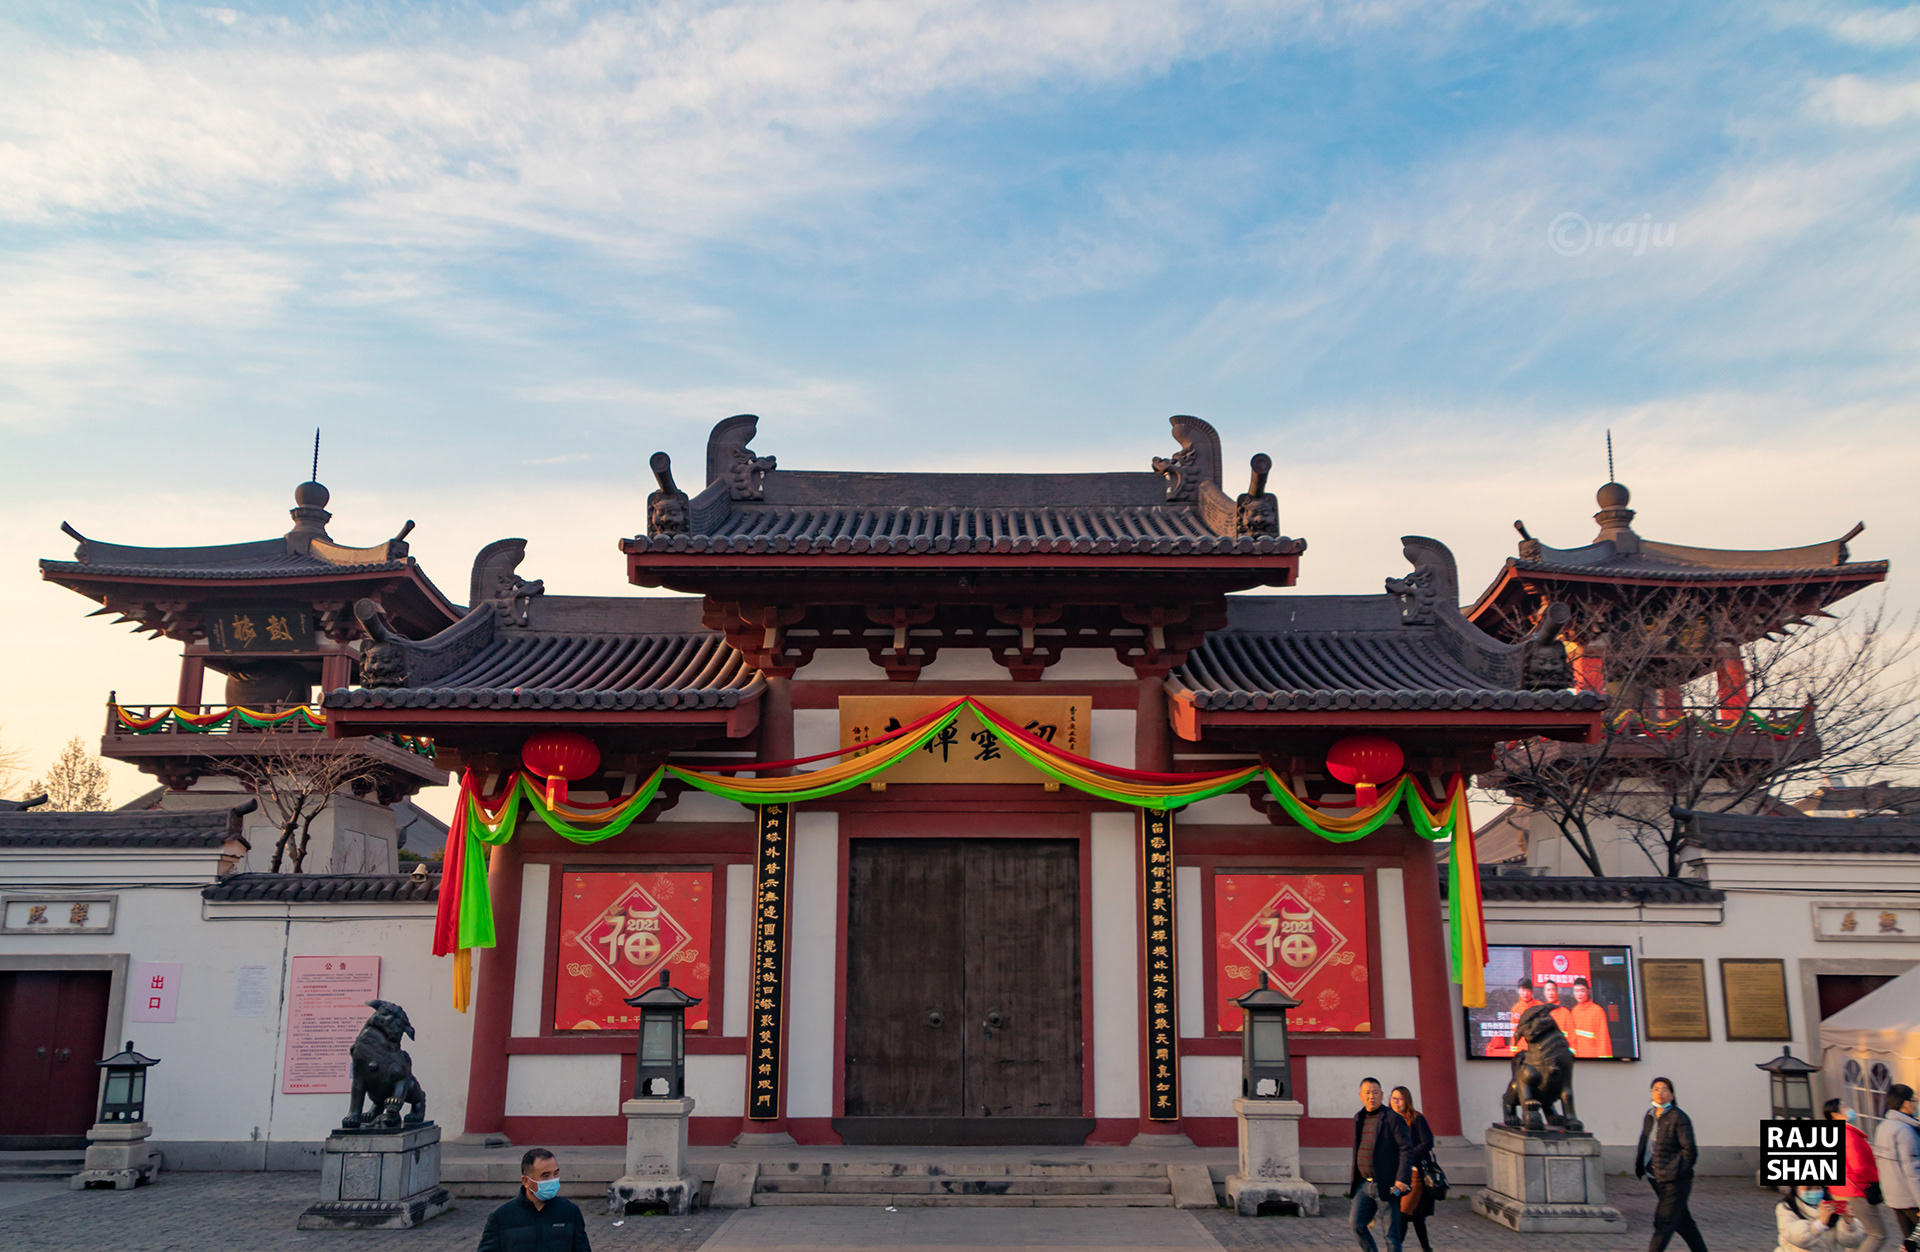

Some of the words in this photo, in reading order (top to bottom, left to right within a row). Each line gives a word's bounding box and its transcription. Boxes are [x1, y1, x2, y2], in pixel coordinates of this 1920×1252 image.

[599, 904, 661, 966] 福
[627, 919, 660, 931] 2021
[1255, 906, 1318, 968] 福
[1281, 921, 1315, 933] 2021
[149, 975, 164, 1009] 出口
